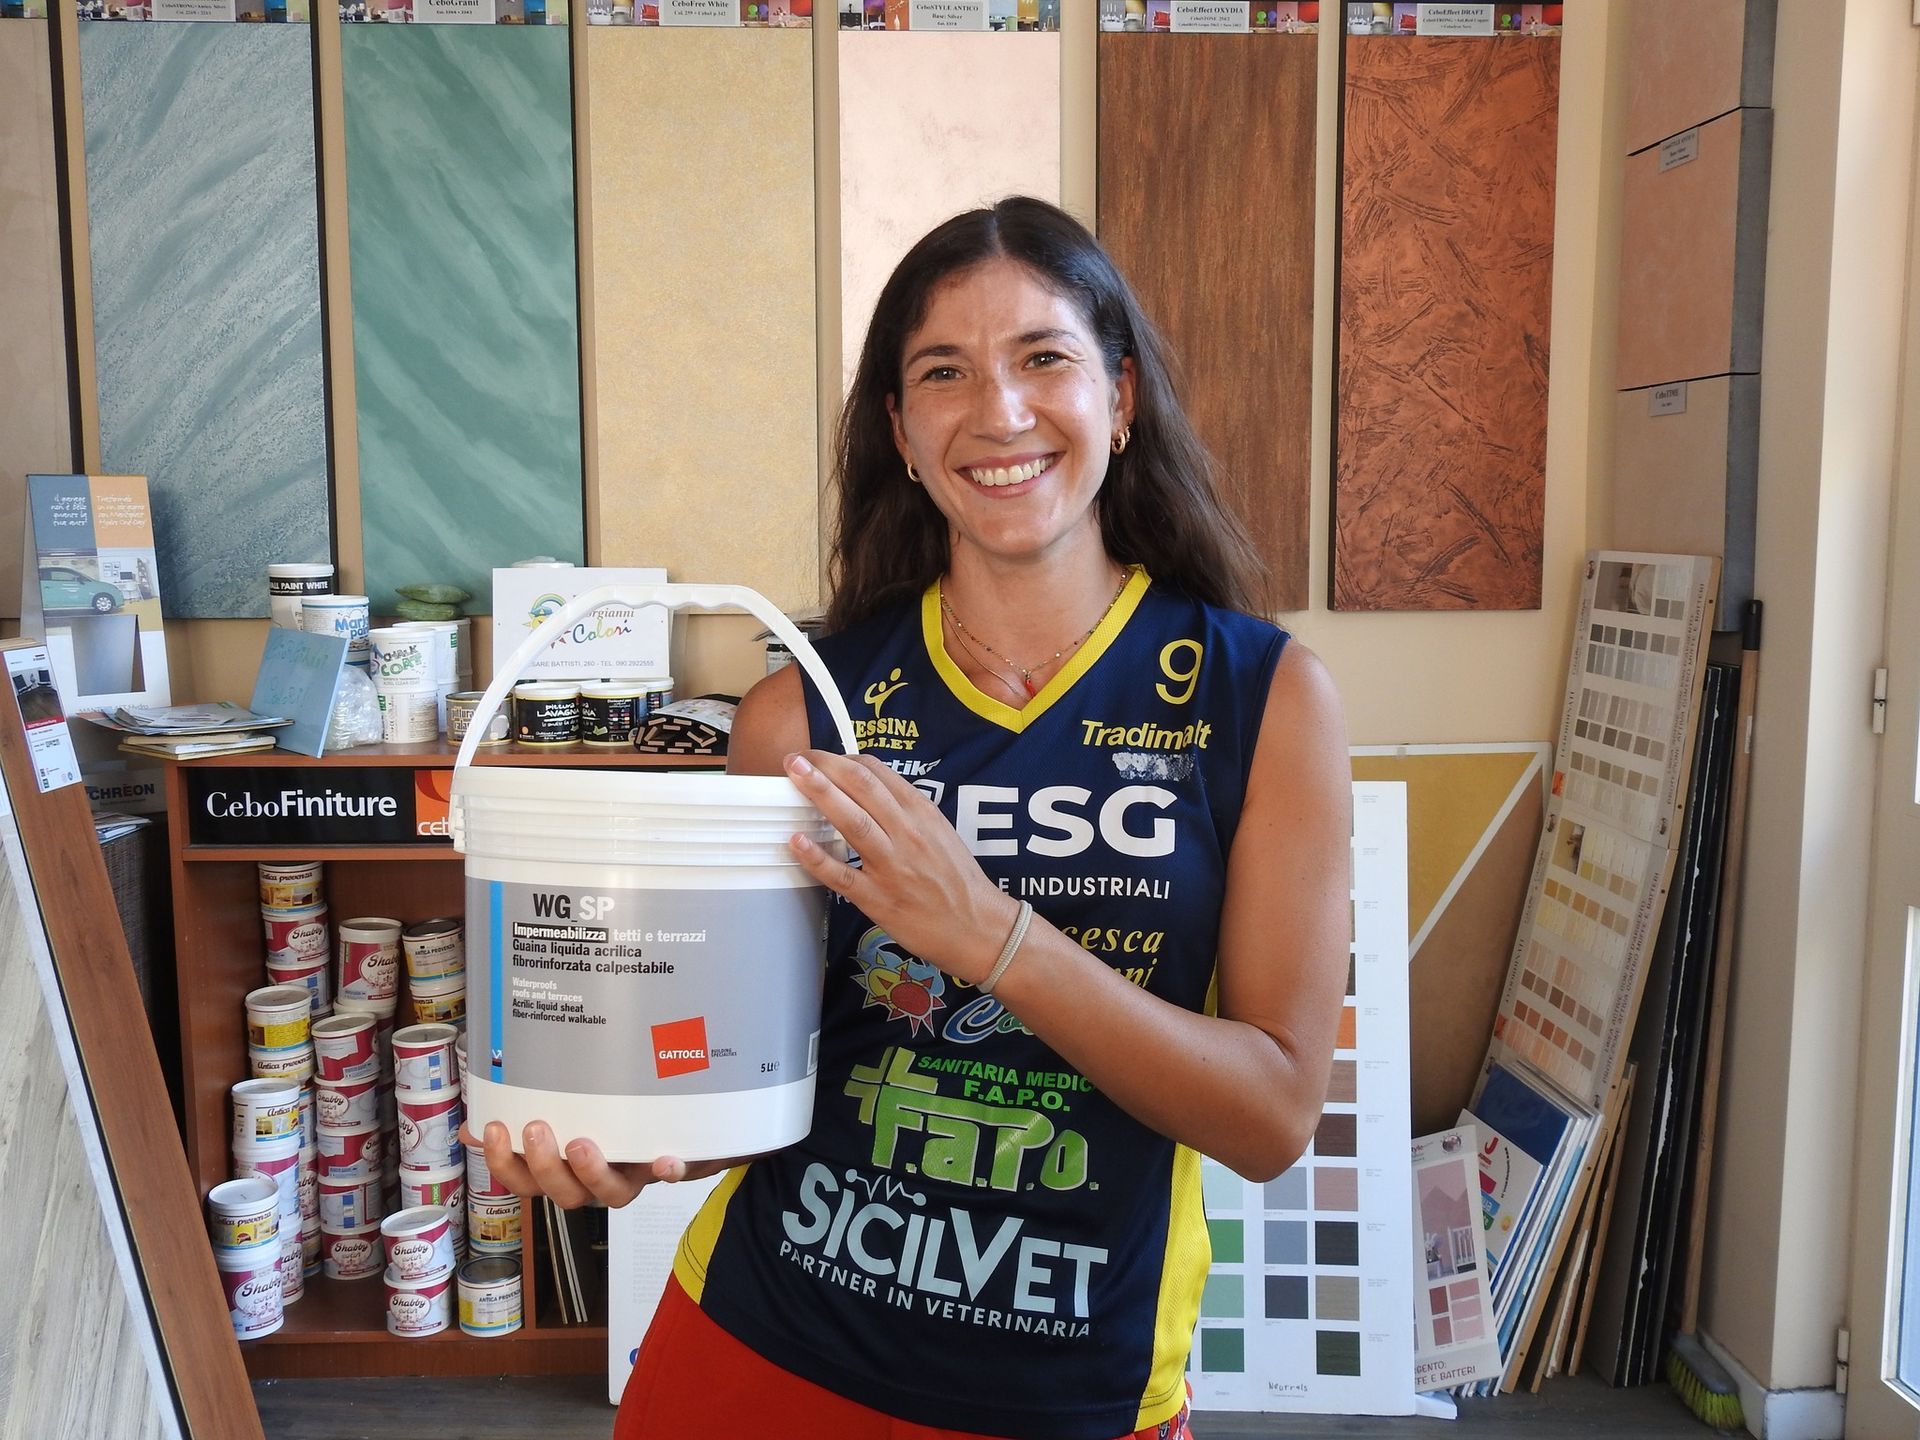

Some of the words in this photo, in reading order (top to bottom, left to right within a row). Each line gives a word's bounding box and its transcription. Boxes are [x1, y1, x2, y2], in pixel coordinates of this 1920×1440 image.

[306, 581, 328, 589] WHITE
[573, 619, 632, 644] Colori
[1155, 639, 1204, 705] 9
[854, 718, 919, 738] ESSINA
[857, 737, 916, 750] OLLEY
[207, 789, 397, 818] CeboFiniture
[956, 784, 1178, 857] ESG
[1021, 877, 1170, 899] INDUSTRIALI
[292, 922, 323, 940] Shabby
[514, 922, 607, 941] Impermeabilizza
[614, 929, 641, 942] tetti
[645, 932, 653, 941] e
[657, 930, 706, 942] terrazzi
[512, 939, 547, 953] Guaina
[551, 942, 590, 957] liquida
[594, 945, 642, 957] acrilica
[512, 955, 591, 972] fibrorinforzata
[596, 960, 674, 975] calpestabile
[512, 977, 557, 991] Waterproofs
[512, 988, 530, 998] roofs
[531, 991, 546, 999] and
[548, 992, 583, 1002] terraces
[512, 998, 534, 1009] Acrilic
[536, 1000, 557, 1012] liquid
[560, 1003, 584, 1013] sheat
[512, 1009, 566, 1022] fiber-rinforced
[568, 1013, 607, 1025] walkable
[659, 1049, 706, 1059] GATTOCEL
[761, 1063, 766, 1072] 5
[918, 1055, 1019, 1087] SANITARIA
[1026, 1072, 1093, 1092] MEDIC
[962, 1080, 1071, 1112] F.A.P.O.
[335, 1243, 368, 1253] Shabby
[394, 1244, 428, 1256] Shabby
[242, 1279, 282, 1297] Shabby
[780, 1240, 877, 1297] PARTNER
[887, 1286, 913, 1311] IN
[925, 1297, 1090, 1338] VETERINARIA
[392, 1296, 426, 1307] Shabby
[1414, 1361, 1446, 1374] GENTO:
[1431, 1374, 1436, 1382] E
[1440, 1365, 1475, 1380] BATTERI
